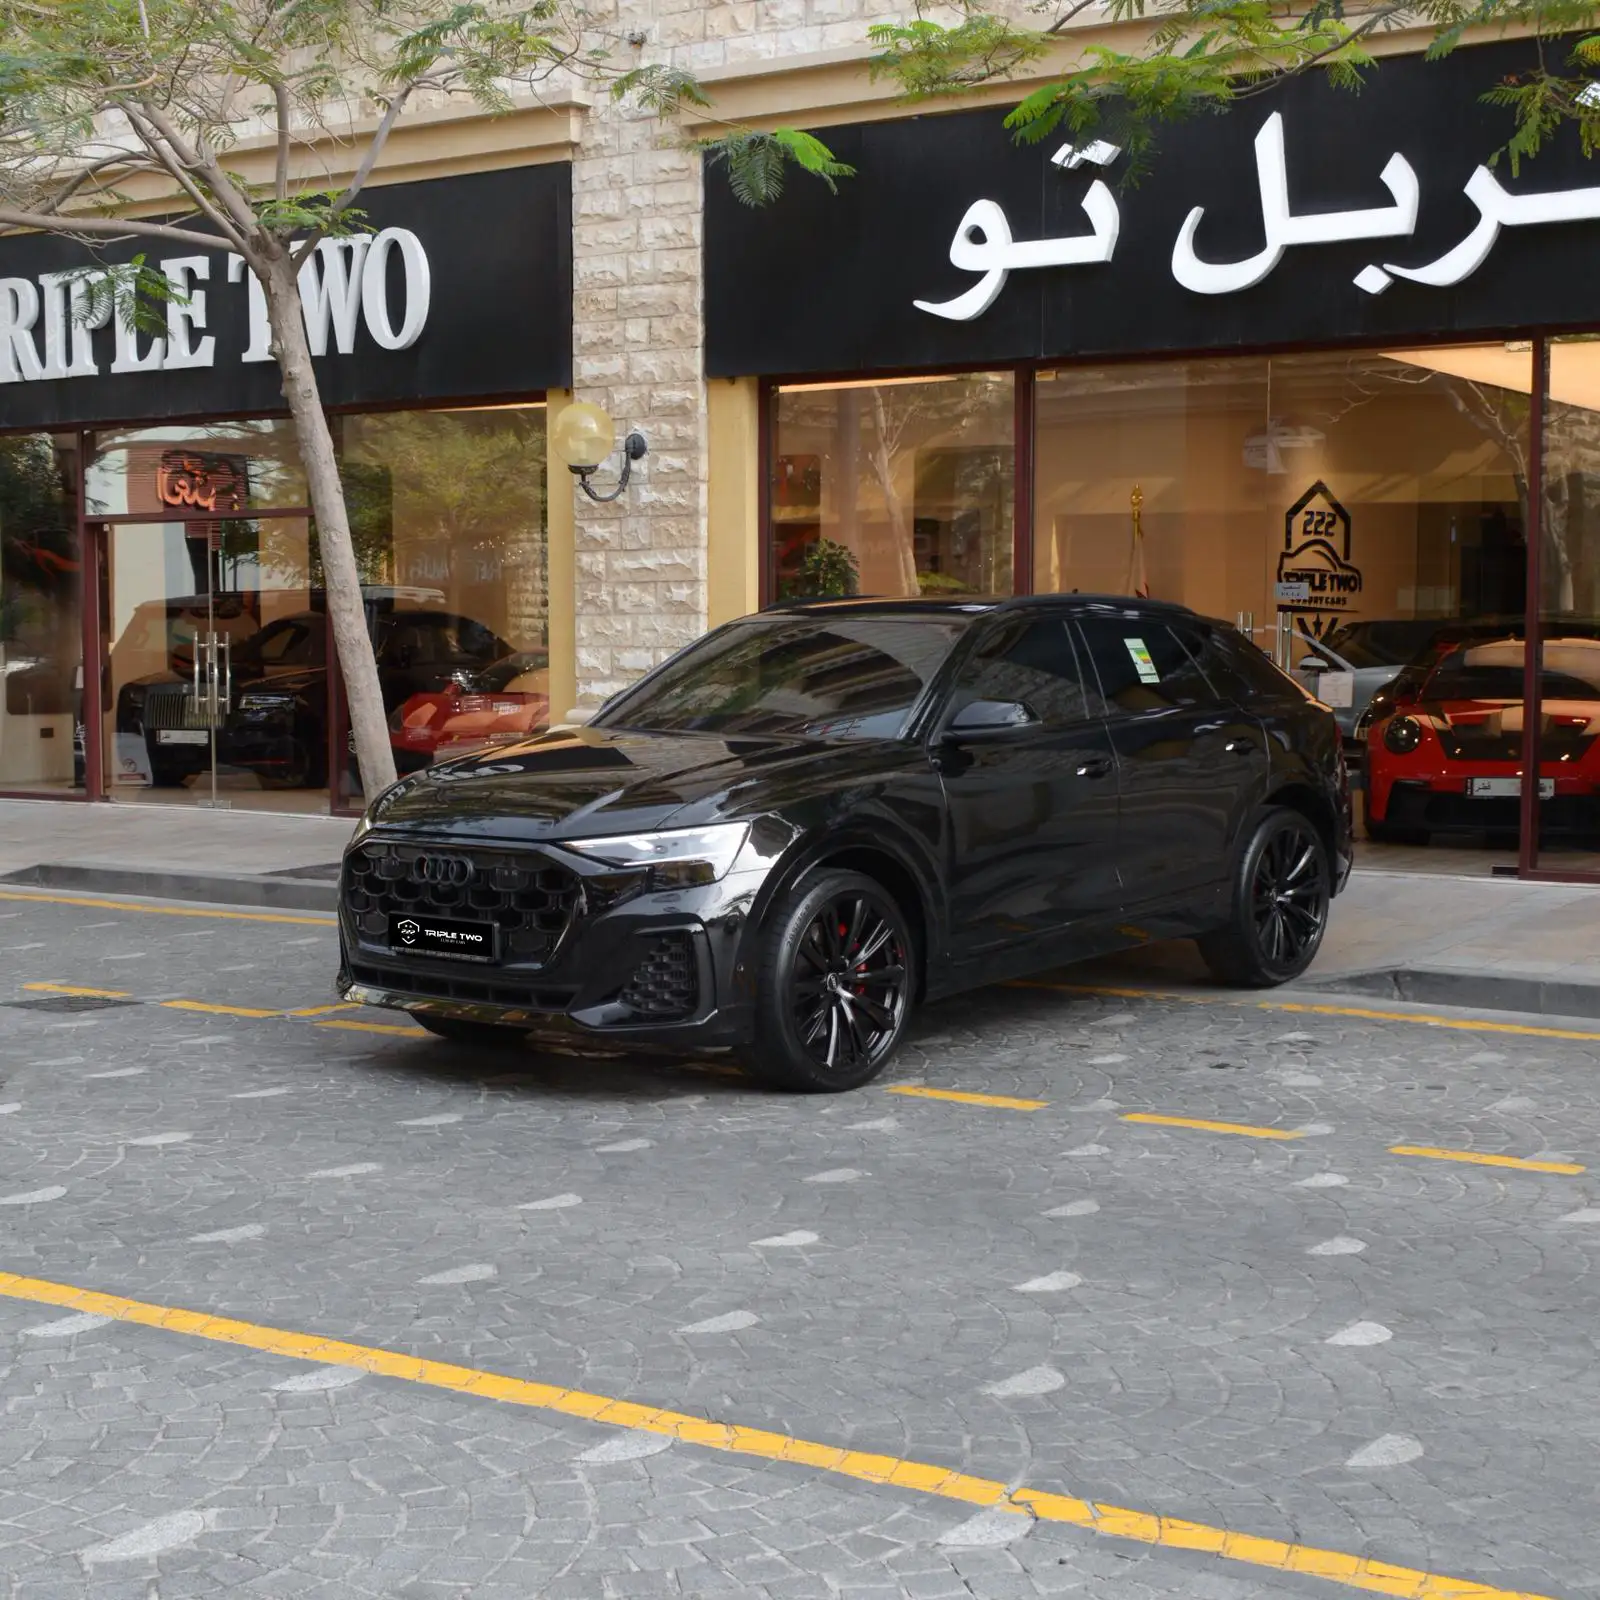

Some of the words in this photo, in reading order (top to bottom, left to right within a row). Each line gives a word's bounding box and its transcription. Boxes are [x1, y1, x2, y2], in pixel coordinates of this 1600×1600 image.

[912, 139, 1121, 322] تو
[1302, 510, 1337, 537] 222
[1329, 574, 1358, 593] TWO
[1325, 597, 1347, 605] CARS
[424, 930, 457, 938] TRIPLE
[460, 933, 482, 941] TWO
